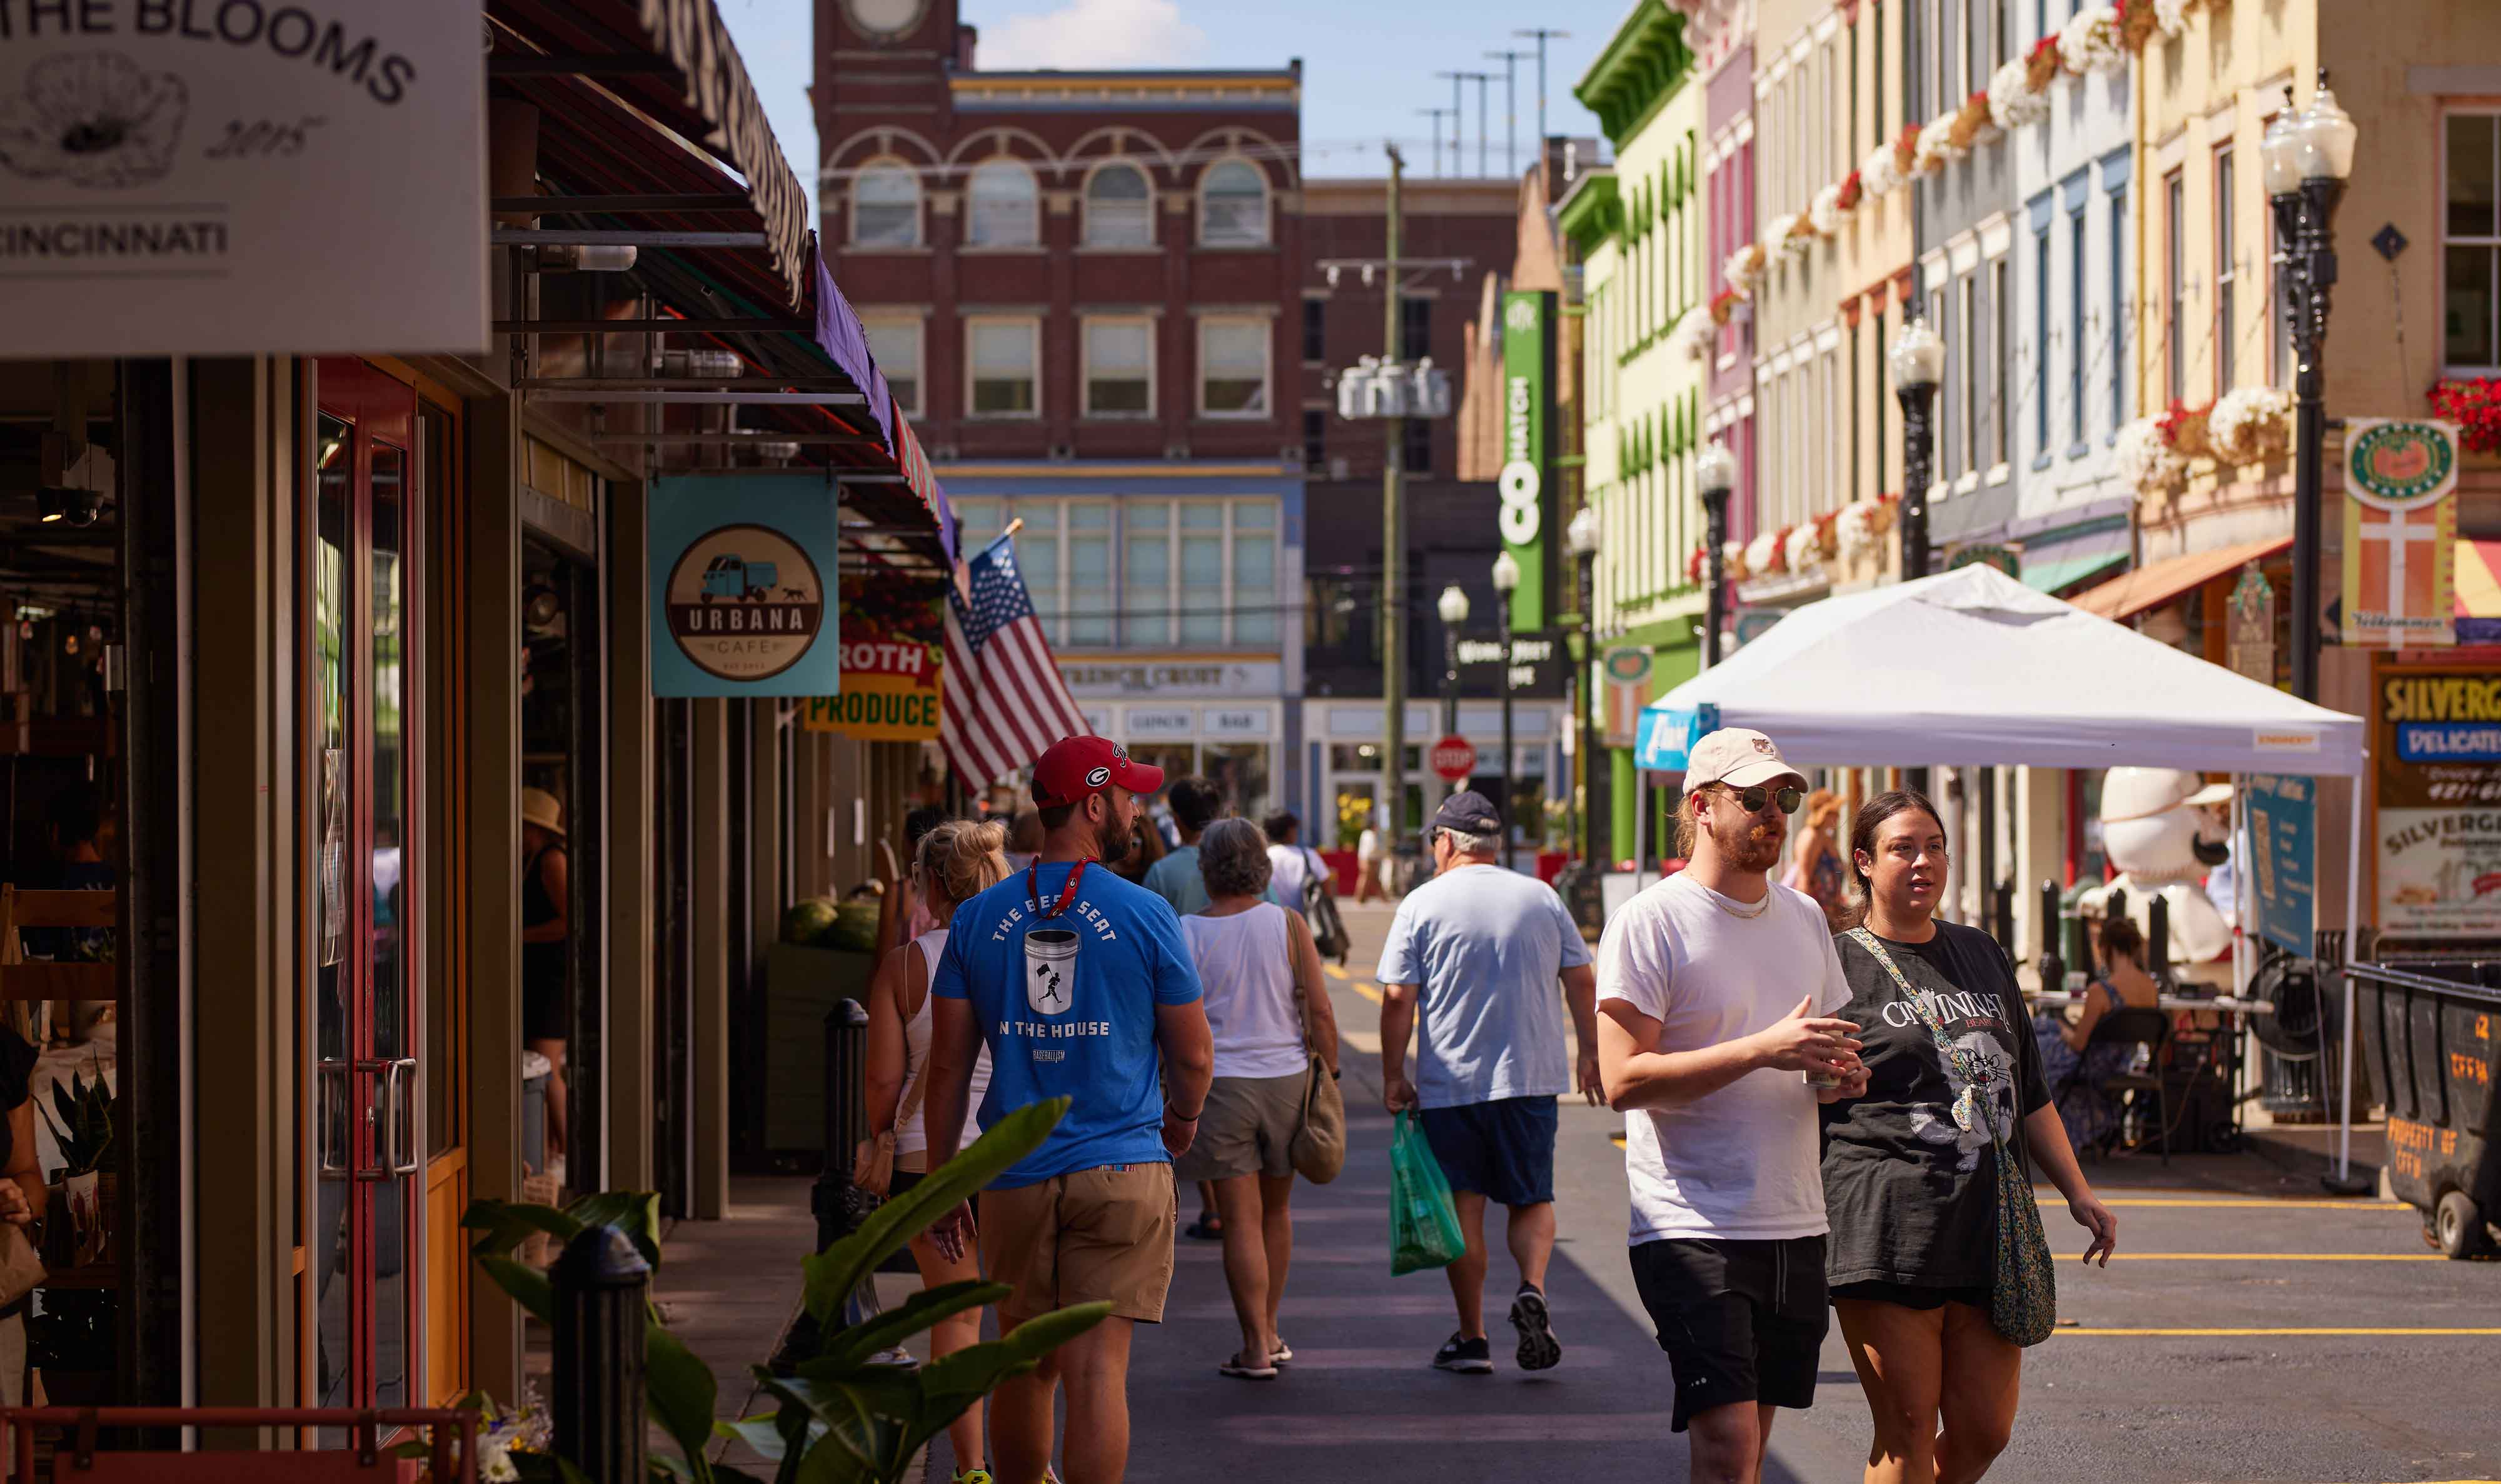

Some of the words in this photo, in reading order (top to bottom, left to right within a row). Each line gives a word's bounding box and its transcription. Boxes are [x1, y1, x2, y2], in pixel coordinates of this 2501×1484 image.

[134, 0, 417, 107] BLOOMS
[203, 115, 328, 160] 2015
[0, 221, 228, 258] INCINNATI
[690, 608, 803, 631] URBANA
[717, 639, 772, 655] CAFE
[839, 642, 923, 674] ROTH
[810, 691, 937, 728] PRODUCE
[2407, 729, 2501, 754] DELICATE
[1436, 750, 1471, 769] STOP
[1086, 767, 1110, 786] G
[992, 908, 1022, 941] THE
[1025, 895, 1075, 913] BES
[1077, 901, 1116, 941] SEAT
[1015, 1021, 1045, 1038] THE
[1052, 1022, 1110, 1038] HOUSE
[1033, 1050, 1065, 1063] BASEBALLISM
[2387, 1115, 2435, 1151] PROPERTY
[2440, 1129, 2458, 1156] OF
